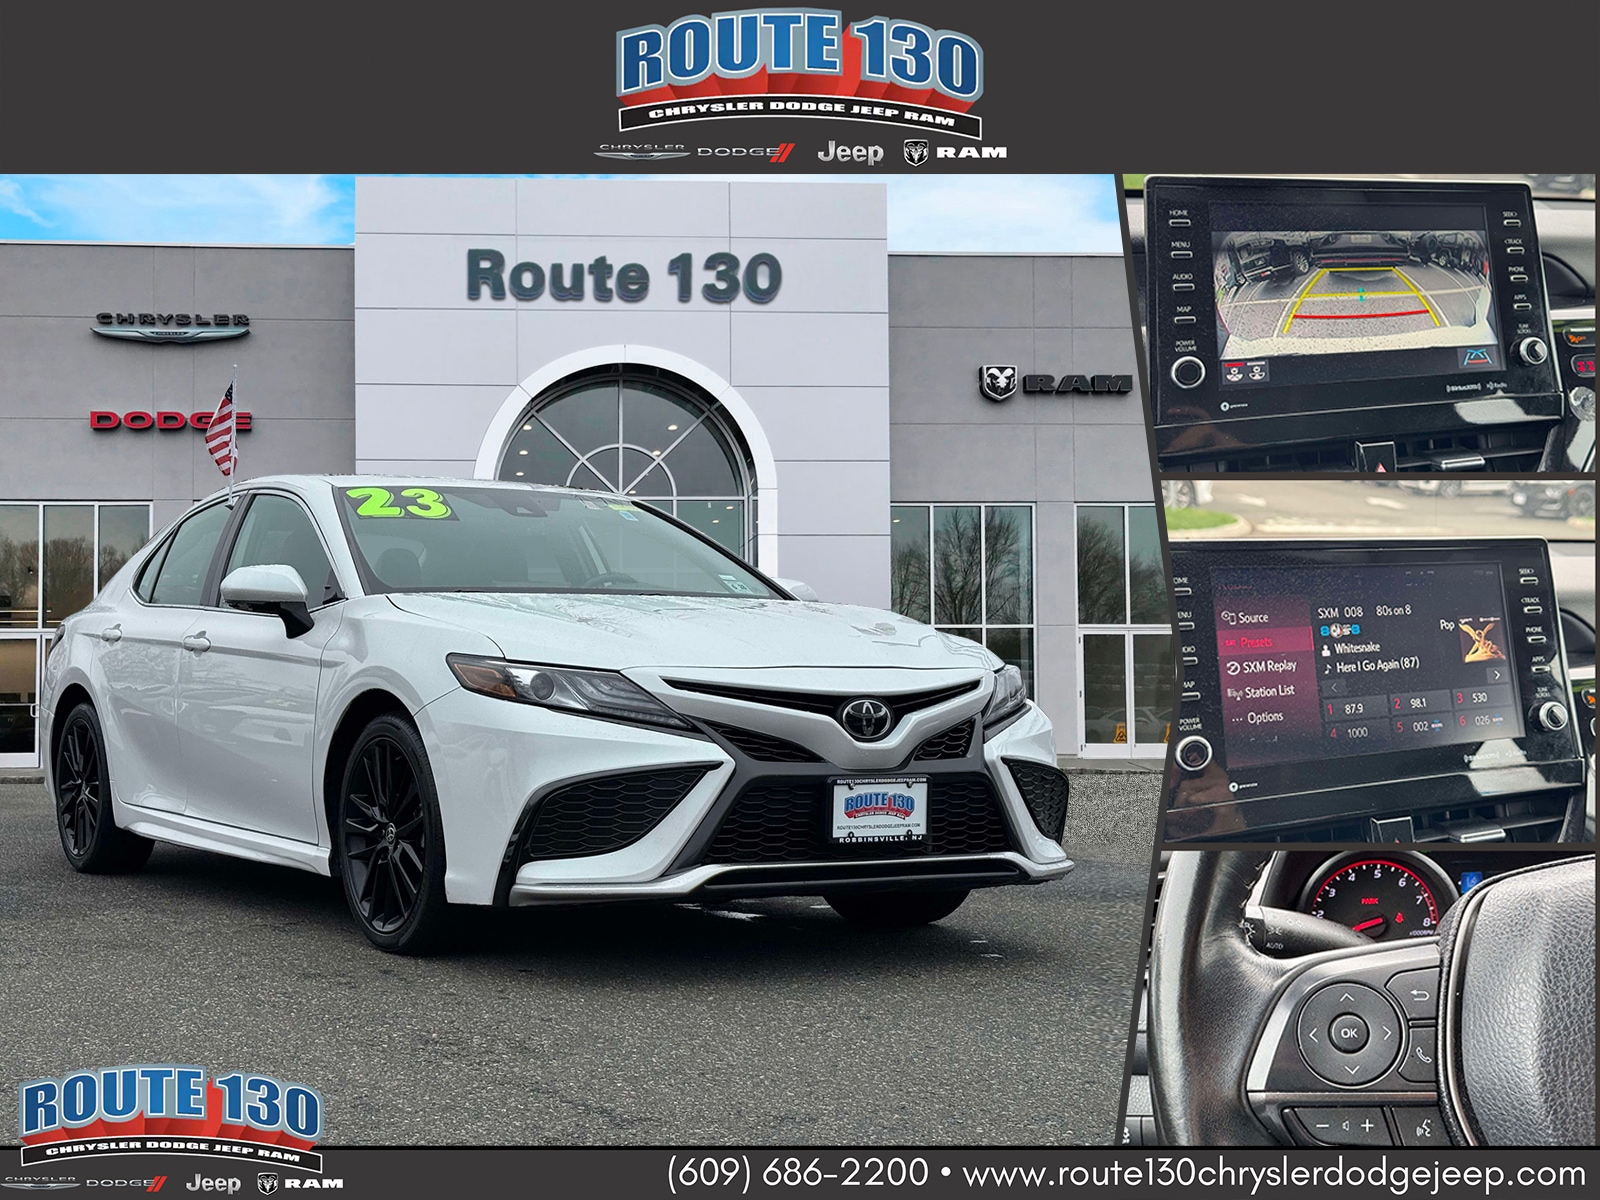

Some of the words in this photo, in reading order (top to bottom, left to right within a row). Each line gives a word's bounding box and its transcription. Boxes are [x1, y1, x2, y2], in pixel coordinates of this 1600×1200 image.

[466, 248, 651, 302] Route
[668, 251, 783, 305] 130
[1176, 305, 1191, 313] MAP
[96, 312, 250, 325] CHRYSLER
[1023, 374, 1133, 394] RAM
[346, 487, 452, 518] 23
[1177, 611, 1192, 619] ENU
[1238, 612, 1269, 623] Source
[1317, 607, 1339, 619] SXM
[1343, 606, 1363, 618] 008
[1375, 605, 1393, 616] 80s
[1393, 607, 1404, 615] on
[1404, 604, 1412, 615] 8
[1440, 619, 1455, 631] Pop
[1241, 637, 1273, 648] Presets
[1333, 641, 1381, 654] Whitesnake
[1243, 660, 1266, 673] SXM
[1267, 659, 1297, 673] Replay
[1336, 661, 1357, 673] Here
[1357, 661, 1361, 671] I
[1362, 660, 1375, 671] Go
[1376, 659, 1400, 672] Again
[1400, 656, 1420, 670] (87)
[1245, 686, 1277, 698] Station
[1278, 684, 1295, 696] List
[1394, 697, 1401, 709] 2
[1409, 697, 1426, 708] 98.1
[1456, 692, 1463, 704] 3
[1472, 692, 1488, 703] 530
[1327, 703, 1333, 715] 1
[1344, 703, 1364, 715] 87.9
[1247, 711, 1284, 725] Options
[1459, 715, 1466, 727] 6
[1474, 715, 1491, 726] 026
[1178, 723, 1202, 731] VOLUME
[1330, 727, 1337, 739] 4
[1347, 726, 1368, 738] 1000
[1396, 721, 1403, 733] 5
[1412, 721, 1429, 732] 002
[844, 791, 889, 812] ROUTE
[890, 792, 915, 812] 130
[839, 835, 908, 843] ROBBINSVILLE,
[1348, 873, 1356, 882] 4
[1374, 869, 1382, 879] 5
[1398, 878, 1406, 887] 6
[1328, 888, 1336, 898] 3
[1416, 895, 1423, 905] 7
[1316, 910, 1324, 919] 2
[1423, 917, 1431, 927] 8
[1265, 942, 1284, 951] AUTO
[1340, 1027, 1358, 1039] OK
